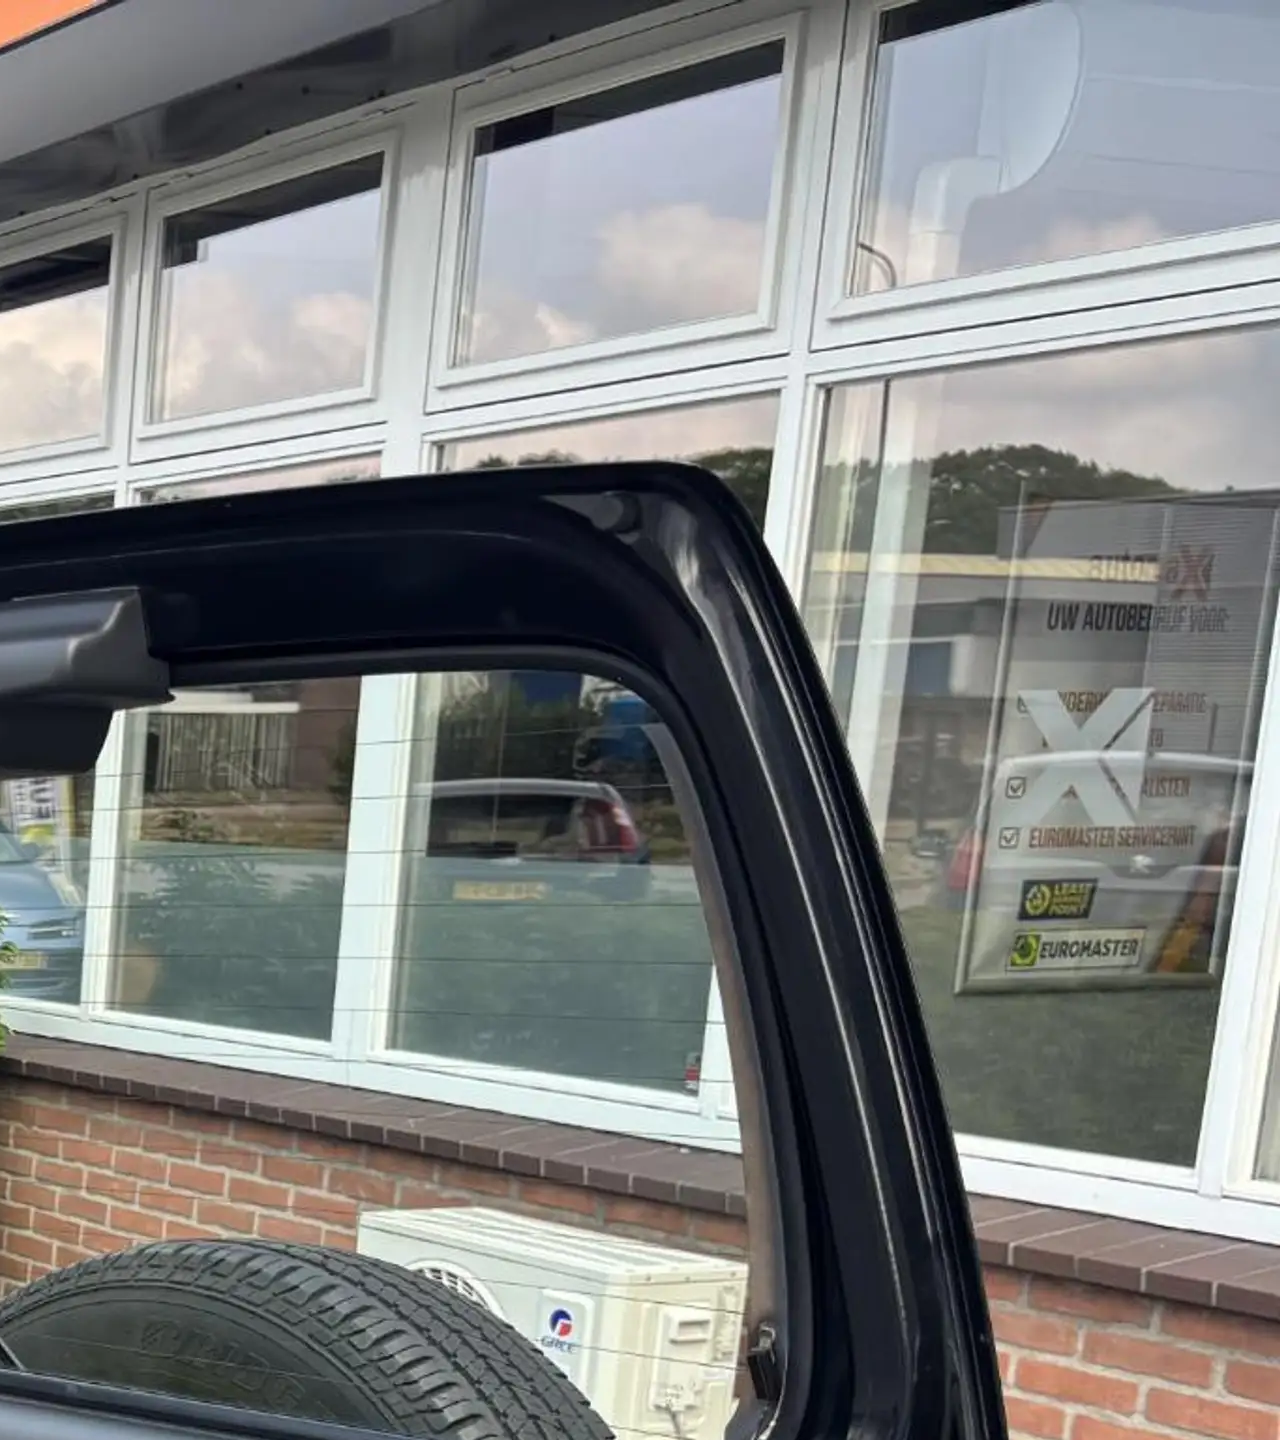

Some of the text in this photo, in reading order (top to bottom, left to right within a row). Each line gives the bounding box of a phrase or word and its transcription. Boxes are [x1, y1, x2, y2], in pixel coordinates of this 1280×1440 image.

[1046, 603, 1080, 631] UW
[1029, 826, 1113, 848] EUROMASTER
[1040, 938, 1138, 959] EUROMASTER
